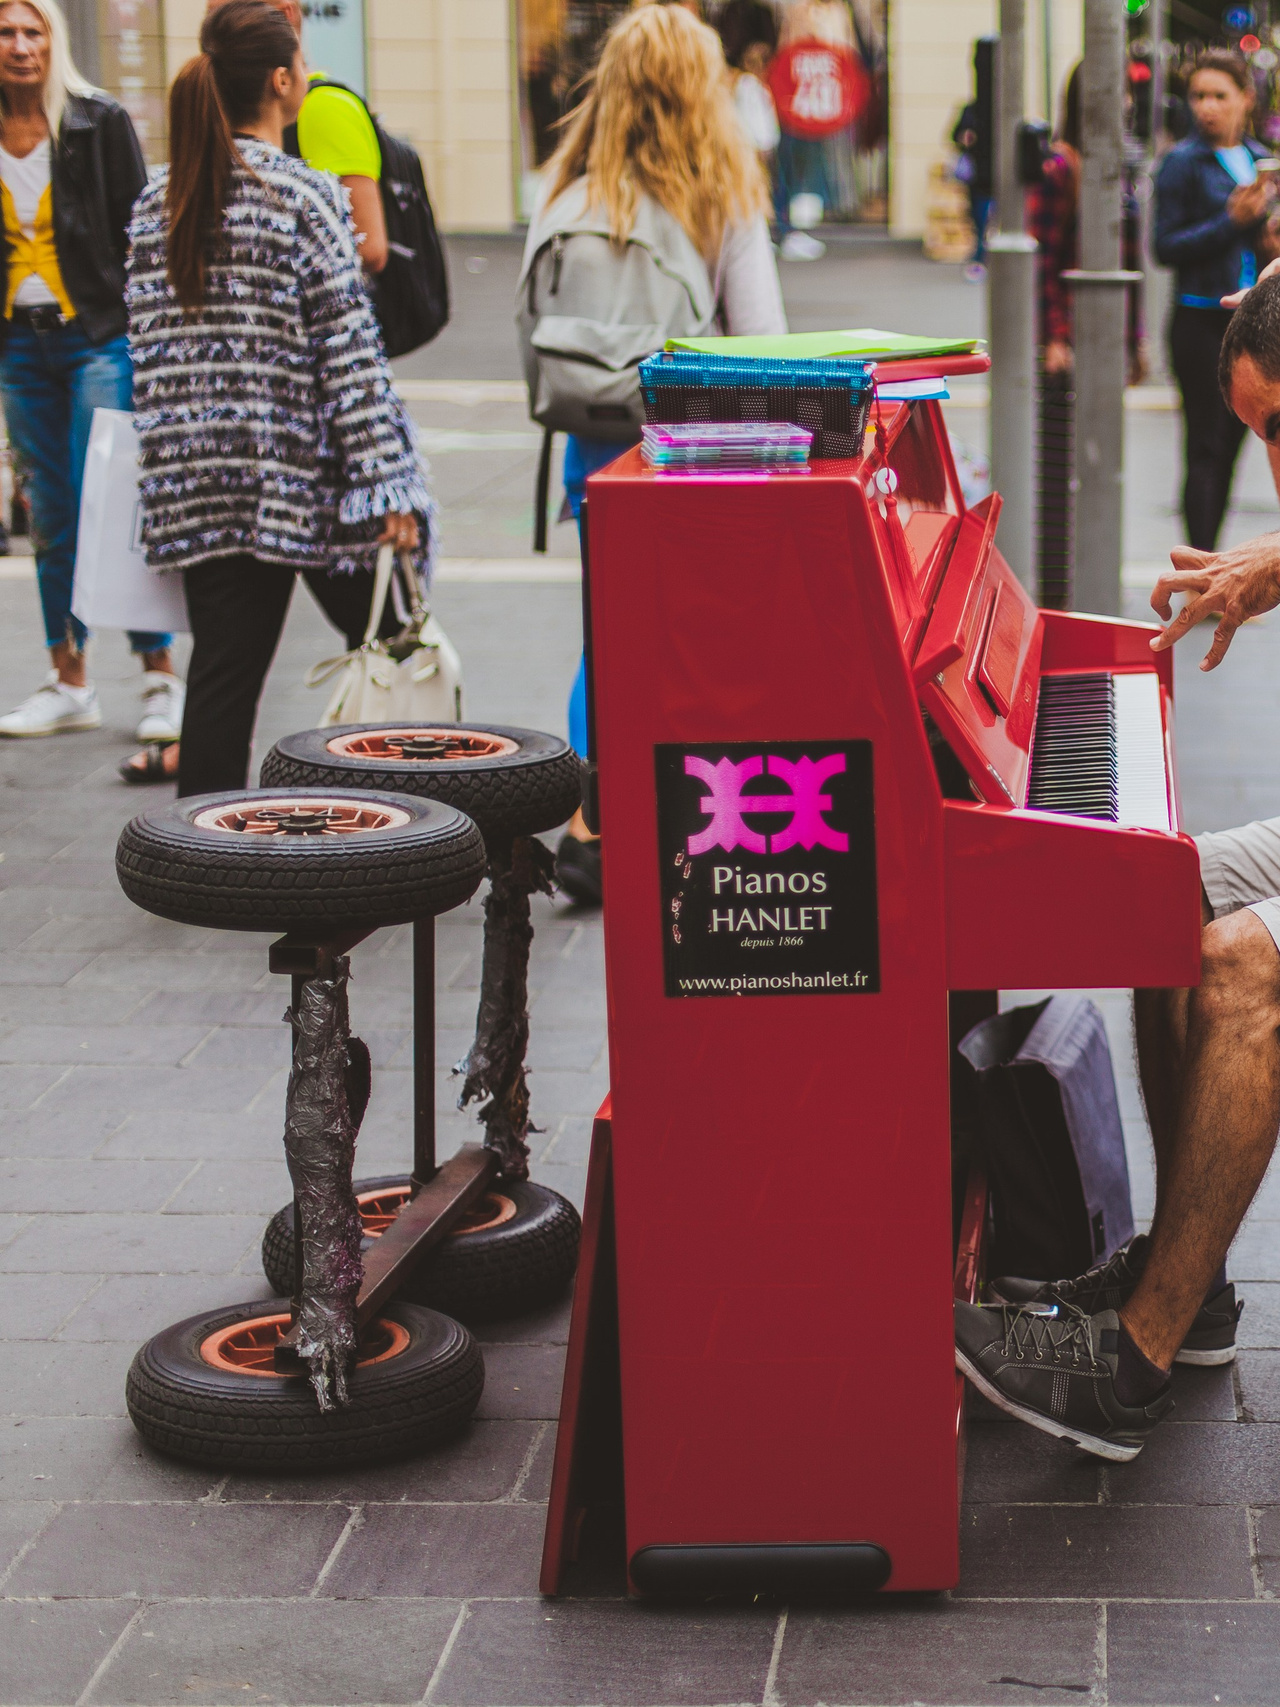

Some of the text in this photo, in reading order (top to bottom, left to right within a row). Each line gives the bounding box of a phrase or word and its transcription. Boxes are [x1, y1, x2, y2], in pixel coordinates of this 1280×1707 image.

[713, 866, 828, 895] Pianos
[712, 907, 833, 932] HANLET
[740, 936, 804, 949] depuis 1866
[679, 971, 869, 991] www.pianoshanlet.fr
